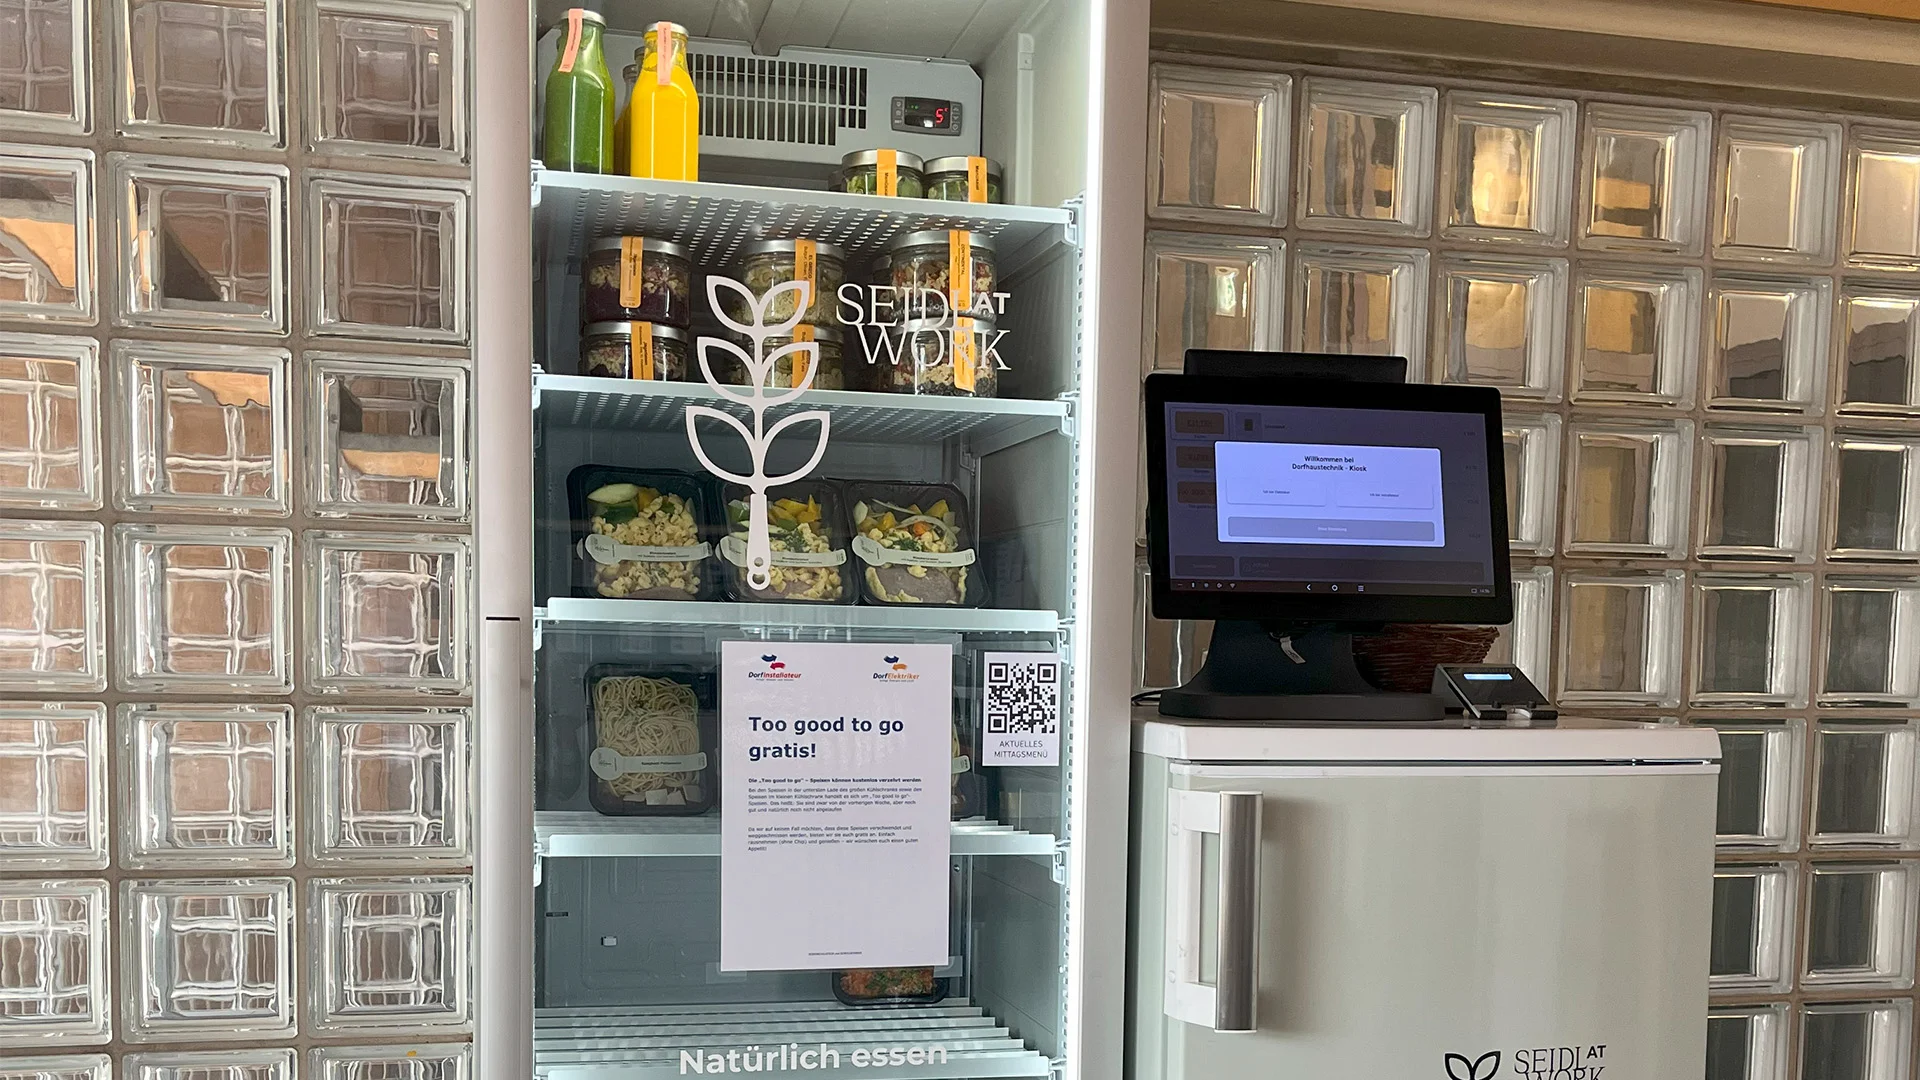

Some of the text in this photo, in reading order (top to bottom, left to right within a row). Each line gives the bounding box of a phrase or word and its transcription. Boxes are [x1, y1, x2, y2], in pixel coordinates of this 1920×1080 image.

[836, 283, 1011, 331] SEIDL AT
[855, 323, 1012, 371] WORK
[1292, 464, 1343, 472] Dorfhaustechnik
[1304, 455, 1343, 463] Willkommen
[873, 672, 920, 680] DorfElektriker
[748, 716, 904, 735] Too good to go
[748, 743, 816, 761] gratis!
[999, 740, 1043, 748] AKTUELLES
[994, 750, 1048, 758] MITTAGSMENÜ
[679, 1042, 947, 1075] Natürlich essen
[1514, 1045, 1607, 1075] SEIDL AT
